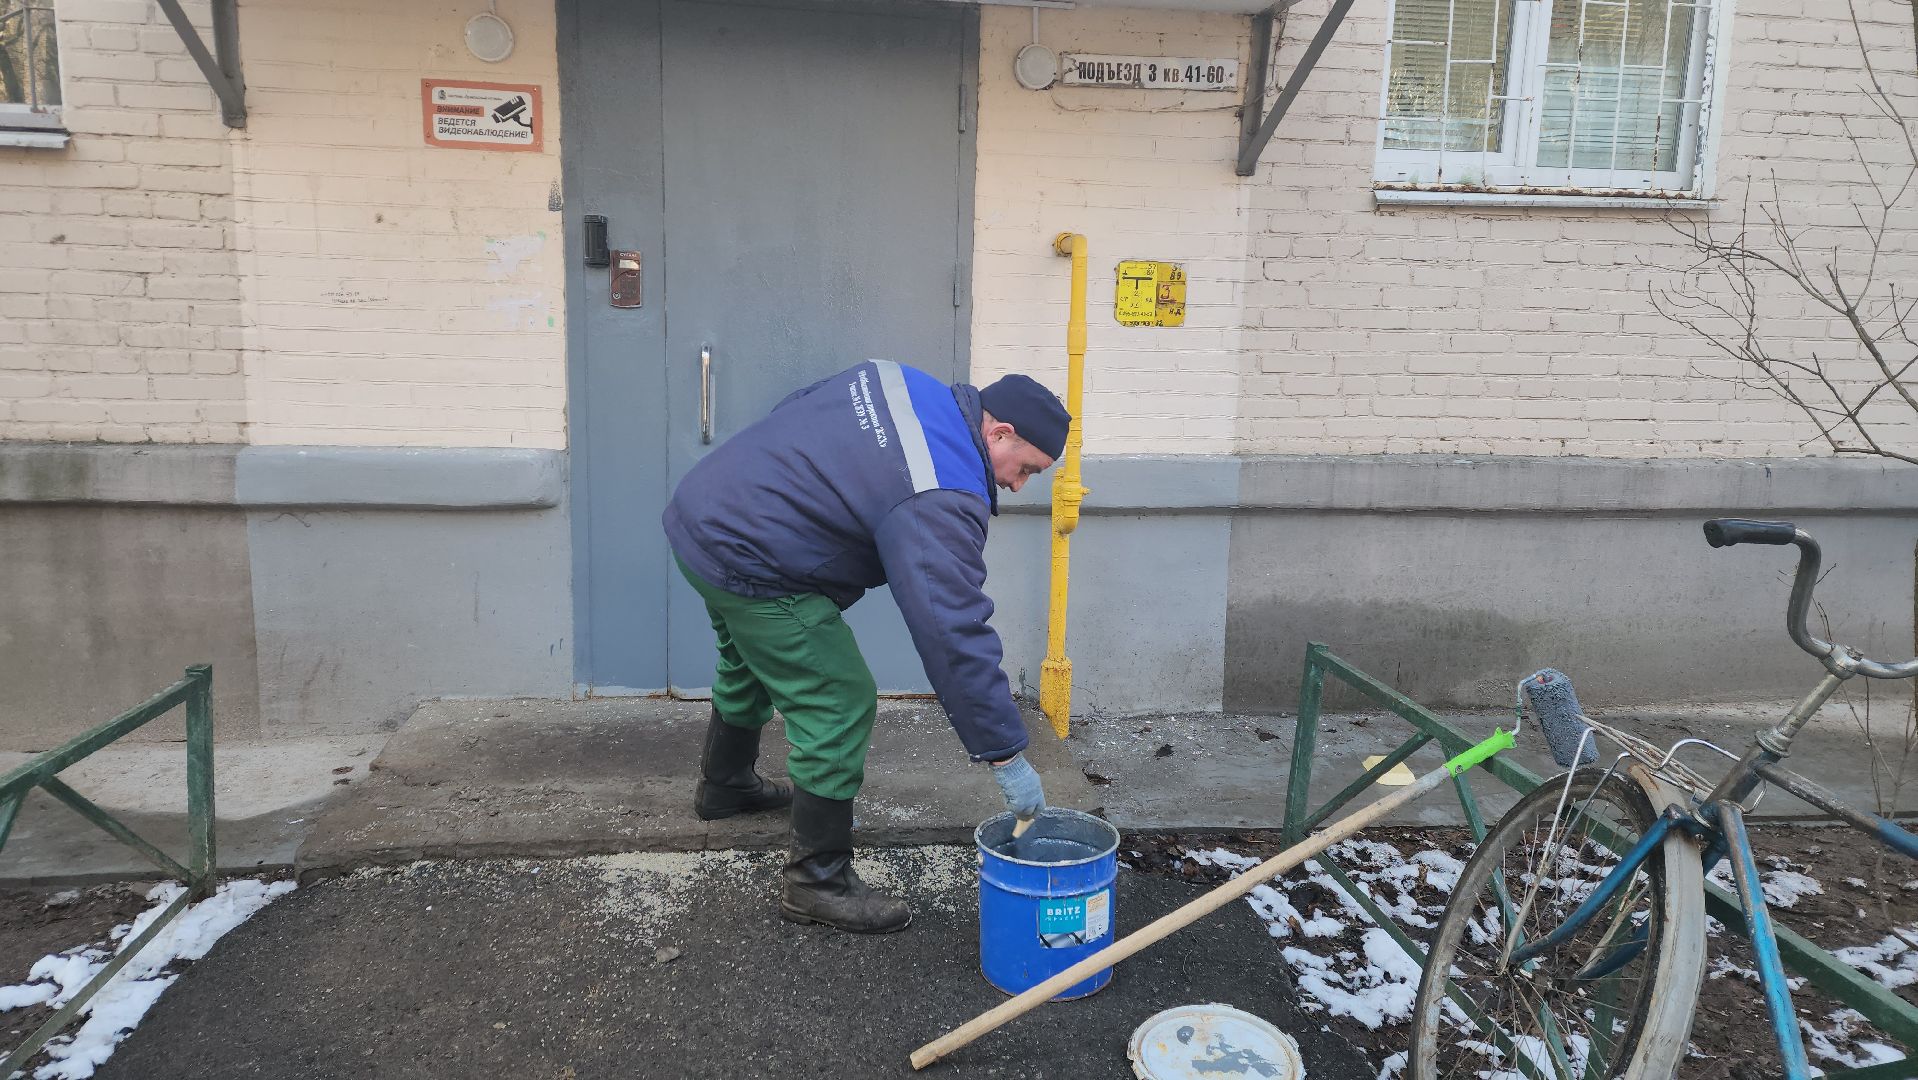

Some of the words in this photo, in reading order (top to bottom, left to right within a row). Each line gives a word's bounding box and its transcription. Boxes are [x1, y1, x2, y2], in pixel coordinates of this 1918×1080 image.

[1078, 61, 1142, 82] ПОДЪЕЗД
[1148, 63, 1157, 82] 3
[436, 105, 480, 115] ВНИМАНИЕ
[437, 117, 477, 127] ВЕДЕТСЯ
[438, 126, 529, 139] ВИДЕОНАБЛЮДЕНИЕ!
[1046, 906, 1081, 916] BRITZ
